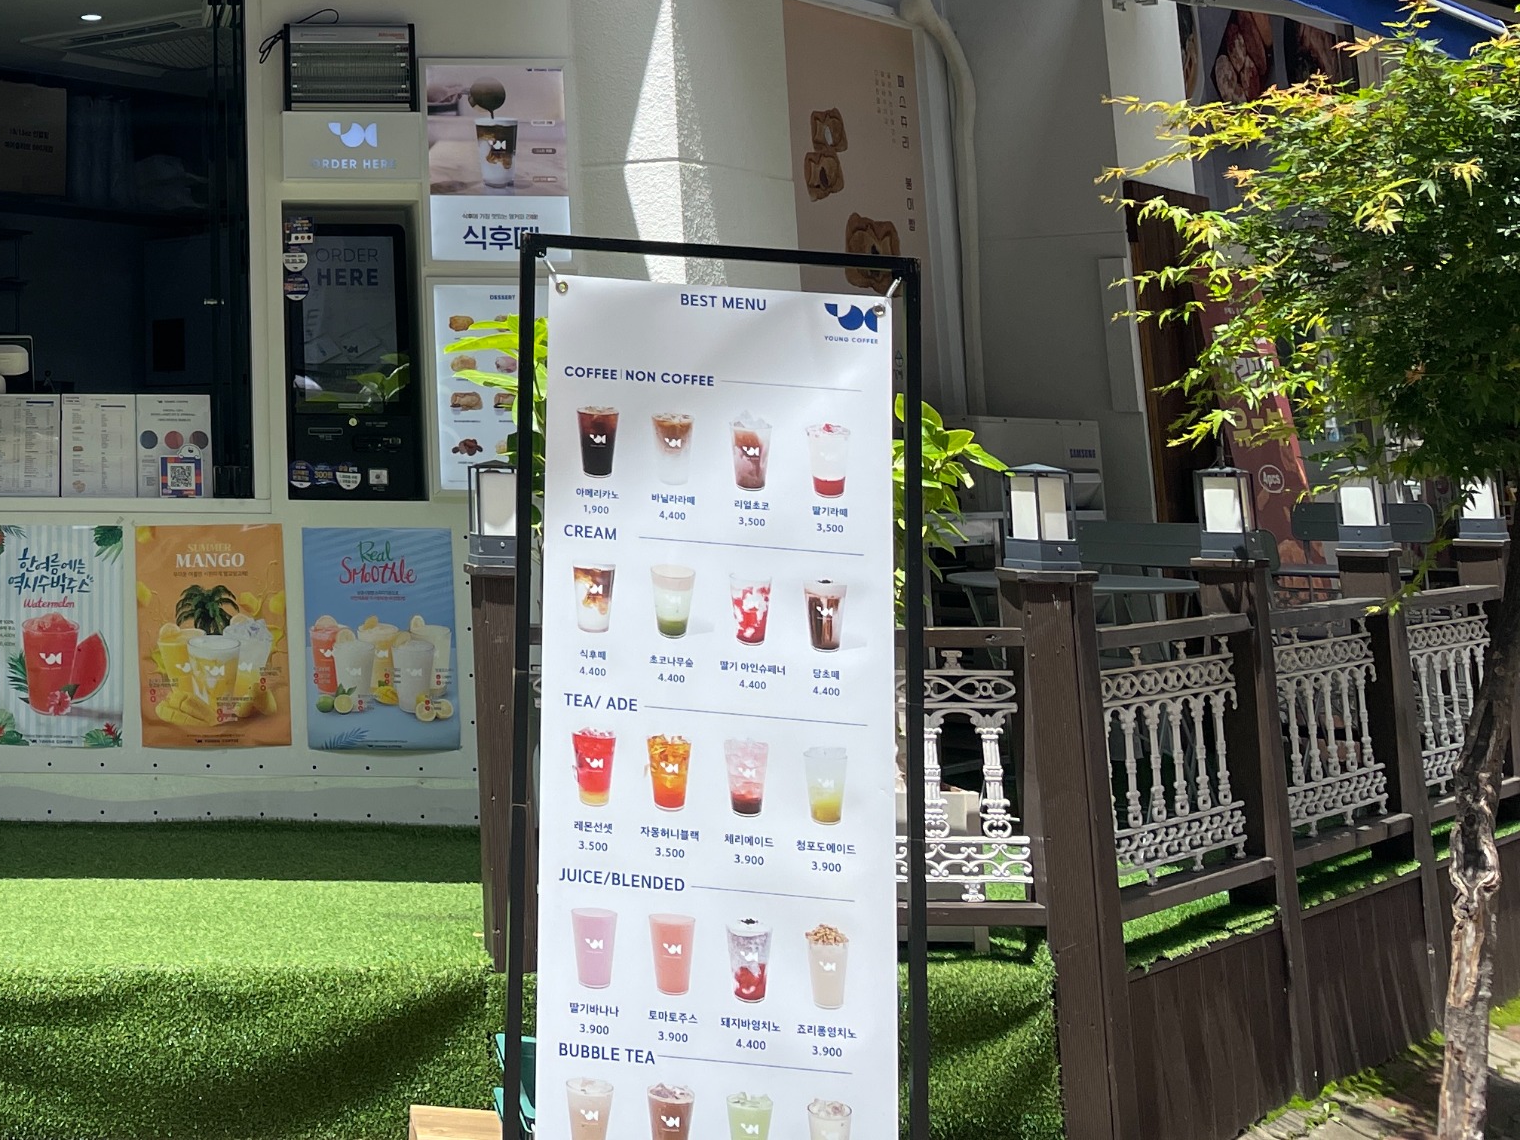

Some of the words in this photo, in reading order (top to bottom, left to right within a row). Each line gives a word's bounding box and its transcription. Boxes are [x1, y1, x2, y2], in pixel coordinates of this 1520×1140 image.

[315, 248, 379, 262] ORDER
[316, 268, 379, 286] HERE
[680, 293, 718, 308] BEST
[722, 295, 767, 311] MENU
[824, 334, 849, 343] YOUNG
[851, 337, 879, 345] COFFEE
[564, 365, 618, 381] COFFEE
[625, 369, 657, 383] NON
[660, 372, 715, 387] COFFEE
[1261, 470, 1282, 488] 4pcs
[575, 486, 620, 500] 아메리카노
[651, 492, 696, 506] 바닐라라떼
[583, 504, 609, 515] 1,900
[733, 498, 770, 511] 리얼초코
[658, 510, 686, 522] 4,400
[812, 505, 849, 518] 딸기라떼
[738, 516, 766, 528] 3,500
[816, 522, 844, 534] 3,500
[563, 524, 618, 541] CREAM
[187, 543, 232, 552] SUMMER
[357, 540, 393, 562] Real
[175, 552, 245, 568] MANGO
[23, 596, 75, 608] Watermelon
[649, 654, 694, 669] 초코나무숲
[579, 666, 607, 678] 4.400
[720, 660, 738, 672] 딸기
[740, 662, 786, 677] 아인슈페너
[657, 672, 685, 684] 4.400
[739, 679, 767, 691] 4.400
[812, 685, 841, 697] 4.400
[564, 692, 602, 709] TEA/
[606, 696, 638, 712] ADE
[573, 820, 613, 835] 레몬선셋
[640, 825, 700, 842] 자몽허니블랙
[578, 841, 608, 852] 3.500
[655, 847, 685, 859] 3.500
[796, 839, 857, 856] 청포도에이드
[734, 854, 764, 866] 3.900
[811, 861, 842, 873] 3.900
[559, 867, 685, 892] JUICE/BLENDED
[569, 1002, 619, 1018] 딸기바나나
[648, 1010, 698, 1025] 토마토주스
[579, 1024, 609, 1036] 3.900
[720, 1017, 782, 1033] 돼지바영치노
[657, 1031, 688, 1043] 3.900
[735, 1038, 766, 1051] 4.400
[558, 1042, 620, 1062] BUBBLE
[625, 1049, 656, 1065] TEA
[812, 1045, 842, 1058] 3.900
